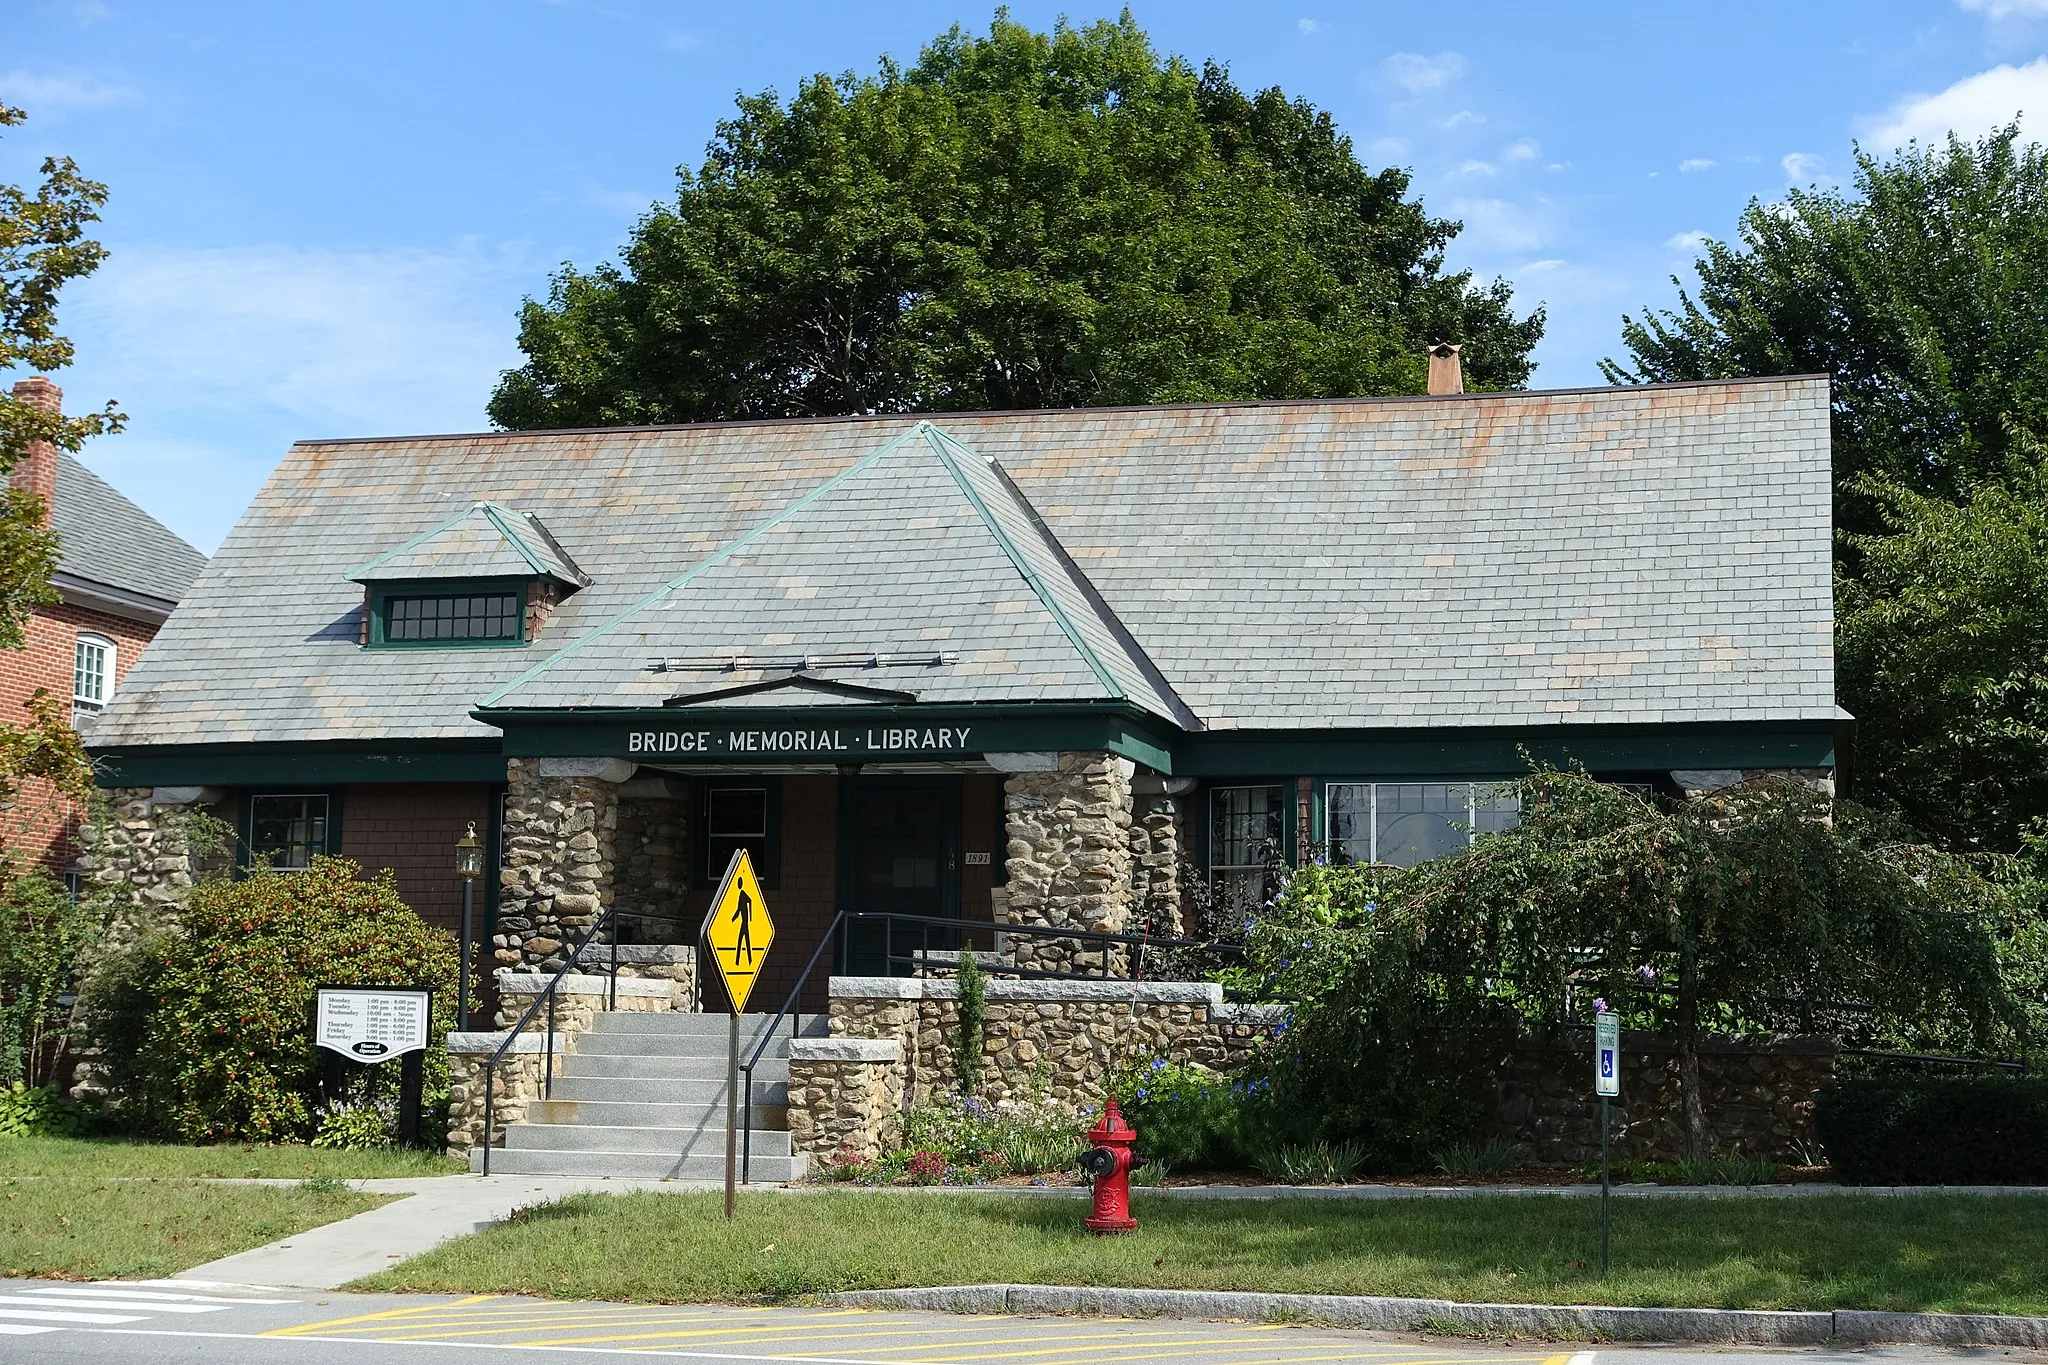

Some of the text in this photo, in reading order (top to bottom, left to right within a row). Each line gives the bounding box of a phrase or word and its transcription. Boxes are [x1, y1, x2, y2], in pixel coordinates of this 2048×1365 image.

[629, 732, 710, 752] BRIDGE
[730, 730, 847, 751] MEMORIAL
[867, 727, 971, 749] LIBRARY
[967, 854, 988, 863] 1891
